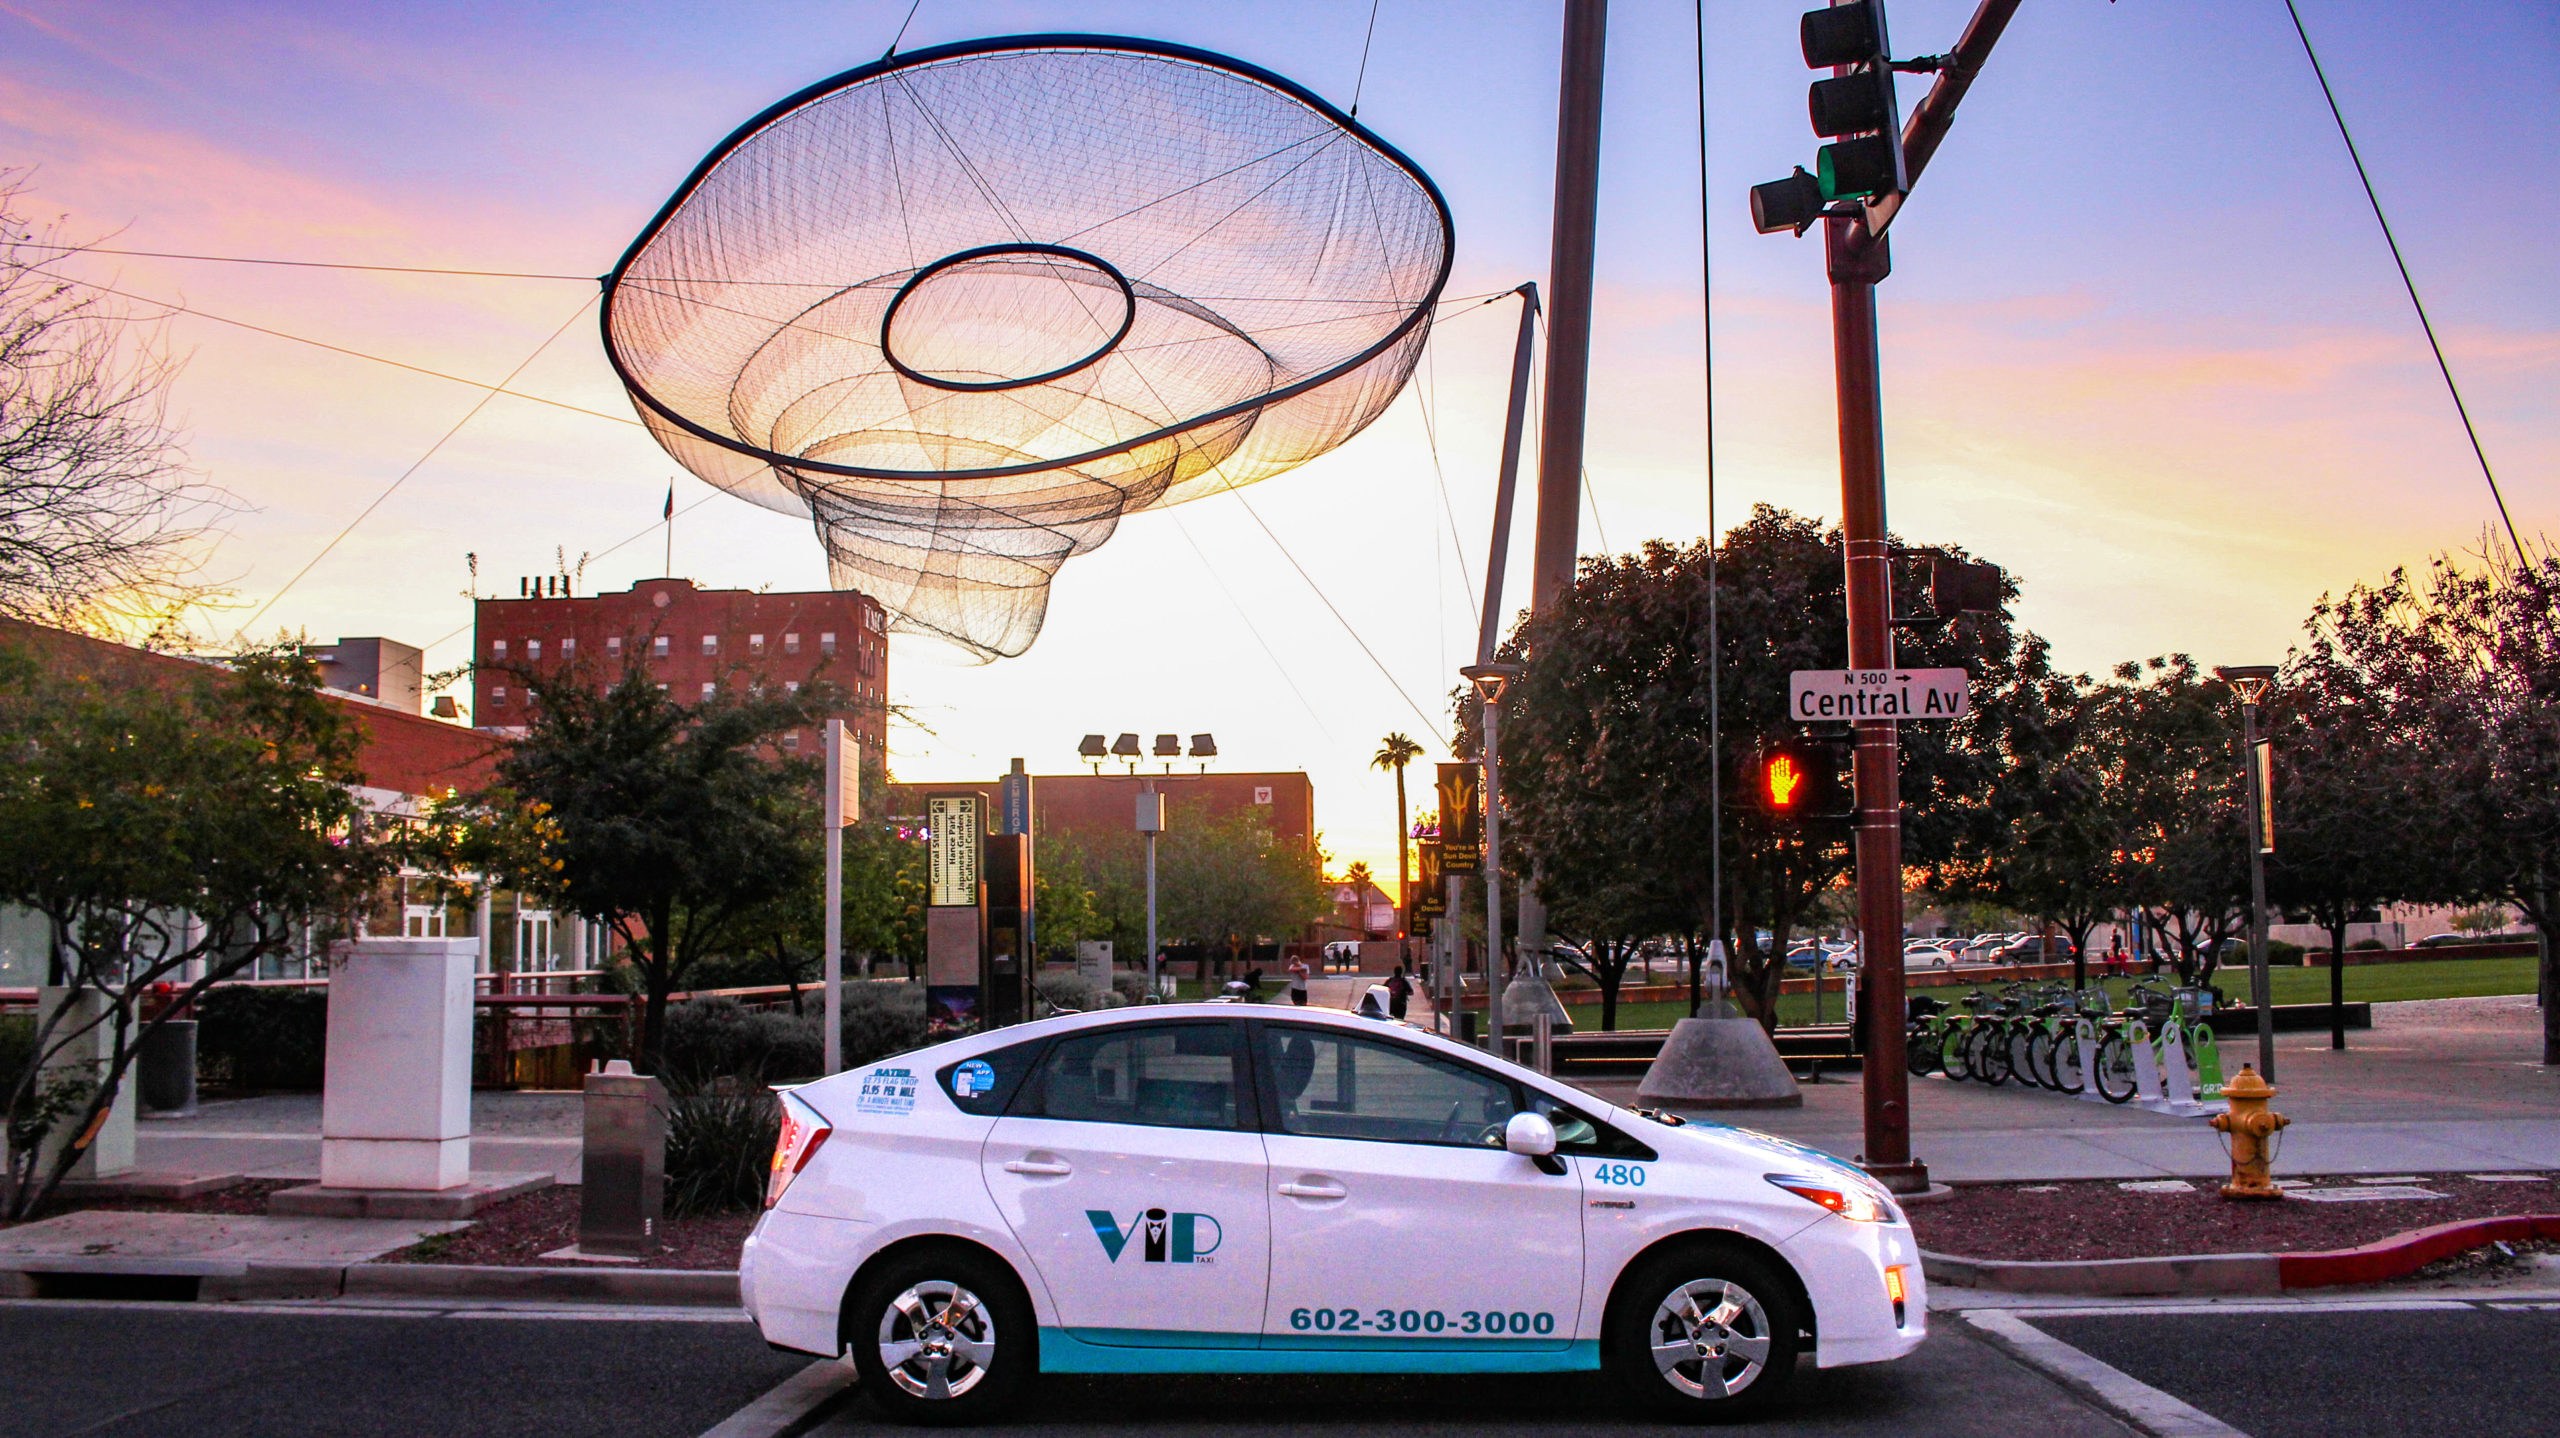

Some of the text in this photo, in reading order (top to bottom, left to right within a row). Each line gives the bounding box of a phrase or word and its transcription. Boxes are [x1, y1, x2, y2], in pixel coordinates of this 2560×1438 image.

[1844, 673, 1887, 685] N 500
[1800, 687, 1959, 716] Central Av
[948, 814, 956, 865] Hance Park
[1445, 843, 1467, 851] You're
[932, 815, 940, 884] Central Station
[957, 814, 966, 892] Japanese Garden
[965, 814, 974, 903] Irish Cultural Center
[1445, 861, 1474, 869] Country
[875, 1068, 911, 1077] RATES
[882, 1077, 899, 1085] FLAG
[901, 1077, 919, 1086] DROP
[861, 1084, 916, 1097] $1.95 PER MILE
[1594, 1163, 1646, 1187] 480
[1196, 1256, 1214, 1264] TAXI
[1290, 1307, 1555, 1334] 602-300-3000
